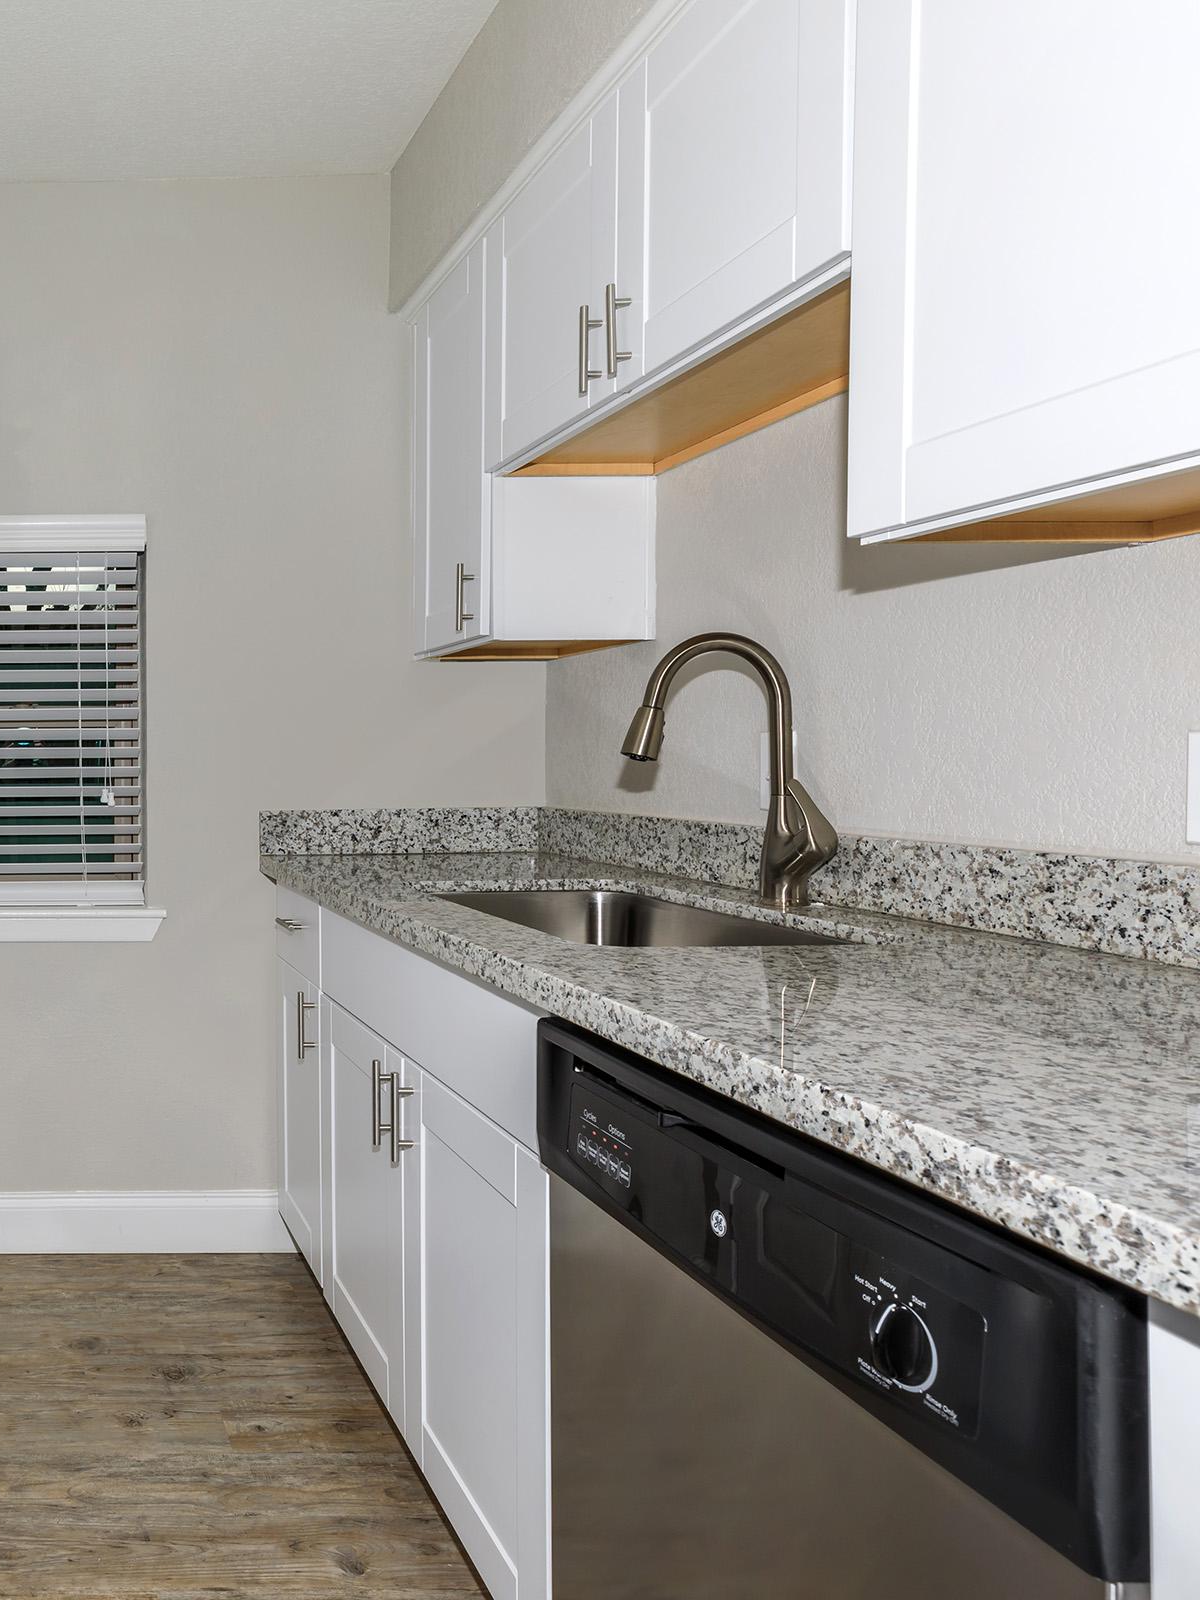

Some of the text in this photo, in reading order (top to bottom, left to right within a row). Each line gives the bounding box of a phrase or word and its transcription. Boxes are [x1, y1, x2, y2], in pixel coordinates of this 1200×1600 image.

[583, 1108, 597, 1123] Cycles
[608, 1123, 626, 1141] Options
[854, 1274, 878, 1293] Hot Start
[879, 1276, 896, 1292] Heavy
[862, 1293, 871, 1303] Off
[911, 1294, 927, 1309] Start
[942, 1404, 958, 1420] Only
